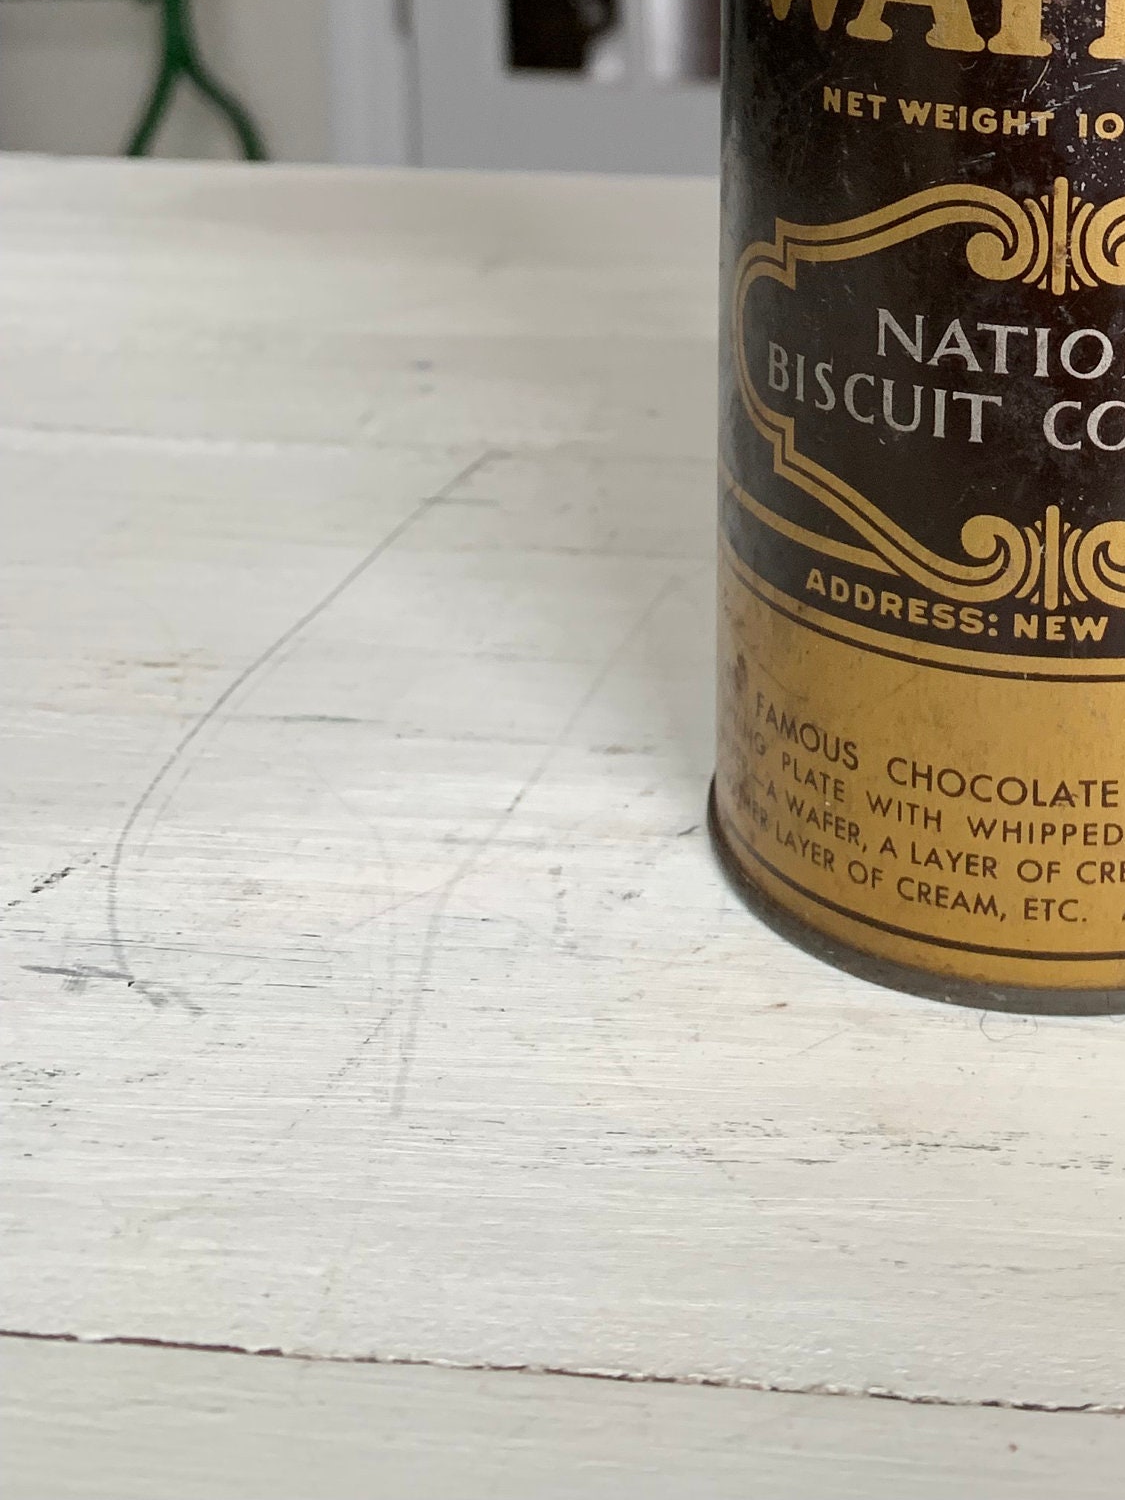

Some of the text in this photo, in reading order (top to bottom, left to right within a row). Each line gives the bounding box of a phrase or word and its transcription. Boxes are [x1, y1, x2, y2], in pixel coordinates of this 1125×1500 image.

[822, 85, 887, 120] NET
[898, 98, 1055, 137] WEIGHT
[1078, 112, 1125, 140] 10
[766, 340, 1003, 445] BISCUIT
[805, 567, 999, 637] ADDRESS:
[1013, 613, 1109, 643] NEW
[755, 691, 859, 771] FAMOUS
[886, 756, 1119, 809] CHOCOLATE
[781, 751, 845, 803] PLATE
[866, 790, 943, 833] WITH
[967, 815, 1124, 847] WHIPPED
[785, 789, 868, 854] WAFER,
[879, 835, 898, 859] A
[910, 840, 998, 880] LAYER
[1016, 859, 1062, 885] OF
[776, 819, 835, 873] LAYER
[847, 859, 884, 890] OF
[896, 875, 1006, 923] CREAM,
[1023, 897, 1088, 923] ETC.
